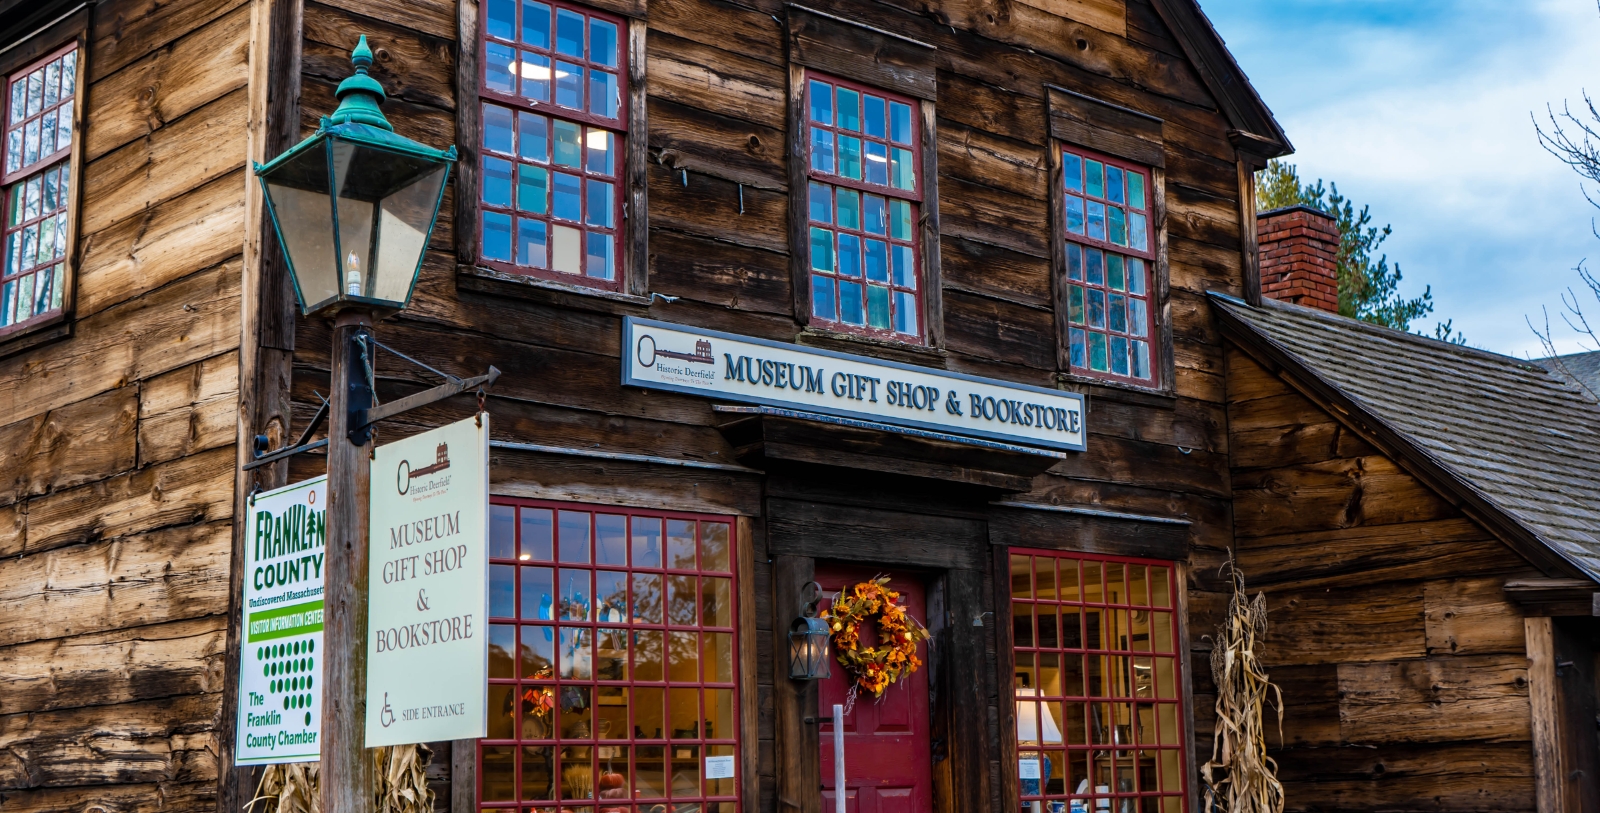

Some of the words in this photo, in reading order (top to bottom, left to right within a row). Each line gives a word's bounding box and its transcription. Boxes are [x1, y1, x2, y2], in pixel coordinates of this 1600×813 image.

[656, 362, 683, 375] Historic
[684, 367, 715, 380] Deerfield
[724, 353, 825, 395] MUSEUM
[831, 372, 881, 403] GIFT
[886, 380, 940, 411] SHOP
[945, 390, 964, 416] &
[968, 393, 1081, 434] BOOKSTORE
[410, 482, 428, 496] Historic
[428, 475, 450, 491] Deerfield
[390, 510, 461, 550] MUSEUM
[253, 552, 325, 592] COUNTY
[383, 554, 420, 584] GIFT
[424, 544, 467, 576] SHOP
[249, 592, 286, 608] Undiscovered
[286, 586, 325, 601] Massachusett
[416, 588, 431, 612] &
[250, 618, 270, 635] VISITOR
[270, 612, 304, 632] INFORMATION
[304, 608, 324, 626] CENTER
[376, 614, 473, 653] BOOKSTORE
[248, 691, 264, 707] The
[247, 710, 281, 727] Franklin
[402, 707, 420, 721] SIDE
[422, 702, 465, 719] ENTRANCE
[246, 731, 276, 750] County
[278, 729, 317, 748] Chamber
